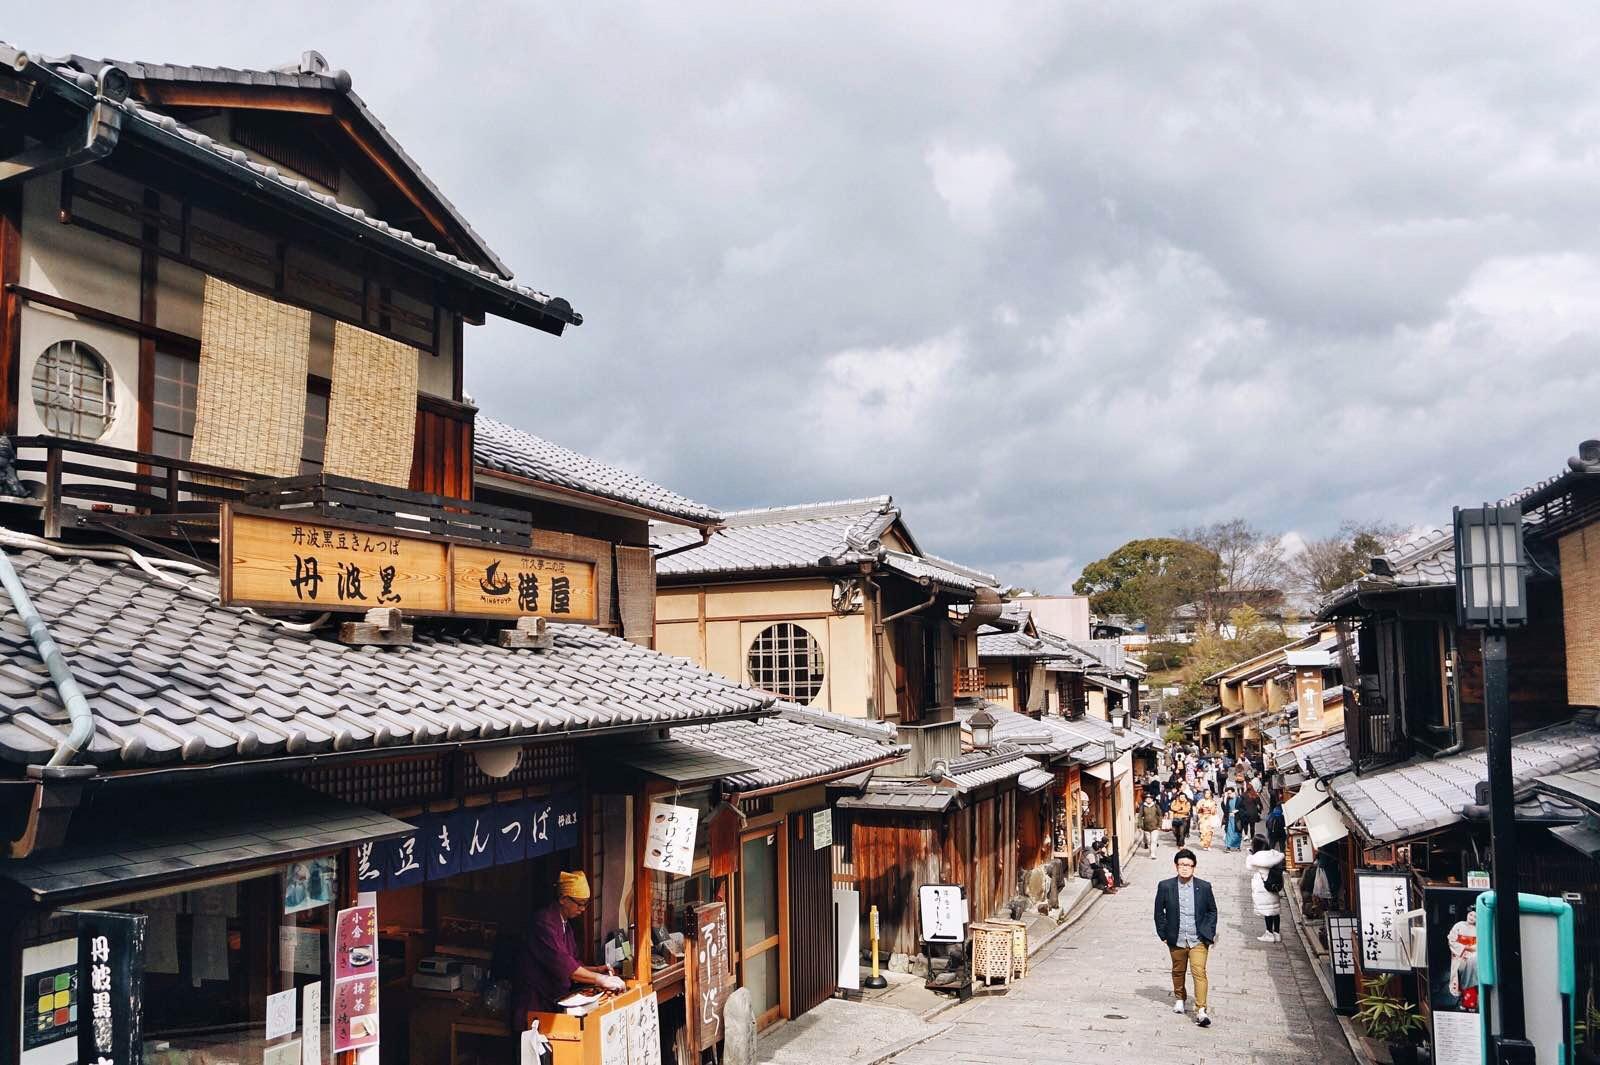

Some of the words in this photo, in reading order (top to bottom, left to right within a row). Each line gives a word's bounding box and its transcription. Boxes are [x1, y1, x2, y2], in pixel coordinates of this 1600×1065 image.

[291, 527, 400, 556] 丹波黒豆きんつば
[290, 554, 402, 604] 丹波黒
[518, 572, 570, 614] 港屋
[357, 806, 552, 881] 黒豆きんつば
[351, 912, 364, 939] 小倉
[1364, 922, 1381, 961] ふたば
[1336, 936, 1352, 968] ふたば
[337, 984, 350, 1039] どら焼き
[352, 982, 365, 1011] 抹茶
